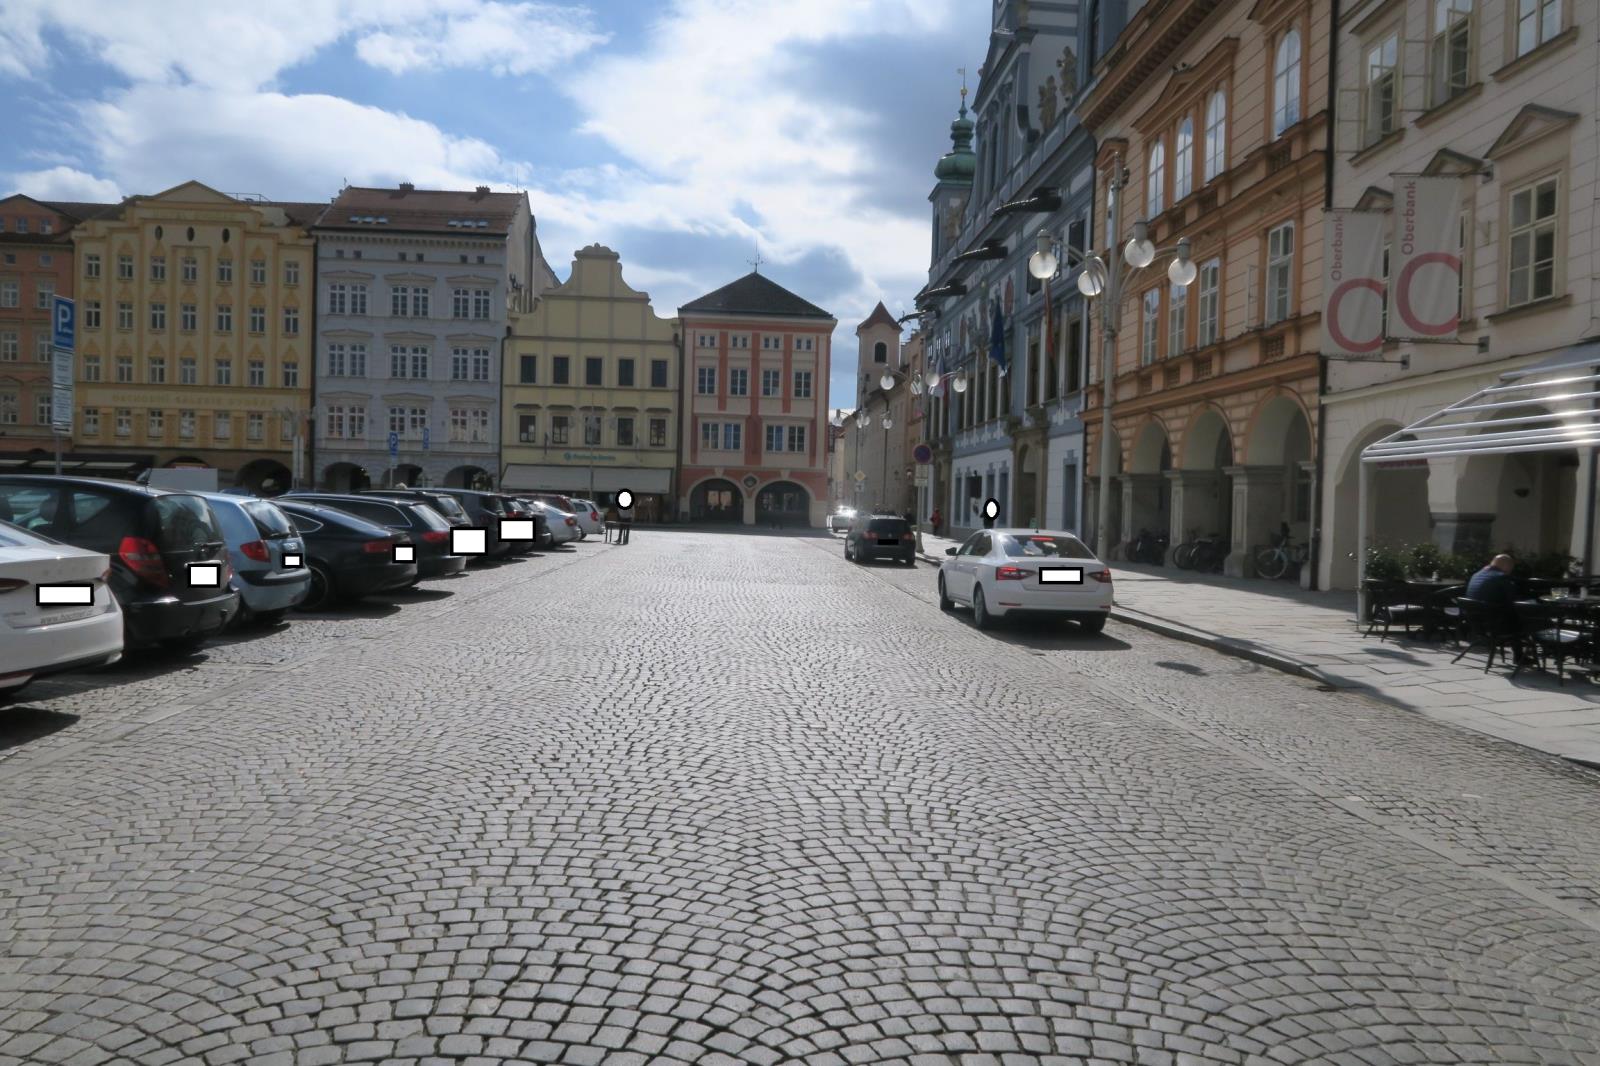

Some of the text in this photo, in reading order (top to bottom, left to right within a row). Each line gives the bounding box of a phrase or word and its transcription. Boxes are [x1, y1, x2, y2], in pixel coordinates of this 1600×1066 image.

[1330, 215, 1345, 282] Oberbank
[1400, 181, 1417, 255] Oberbank
[58, 303, 71, 332] P
